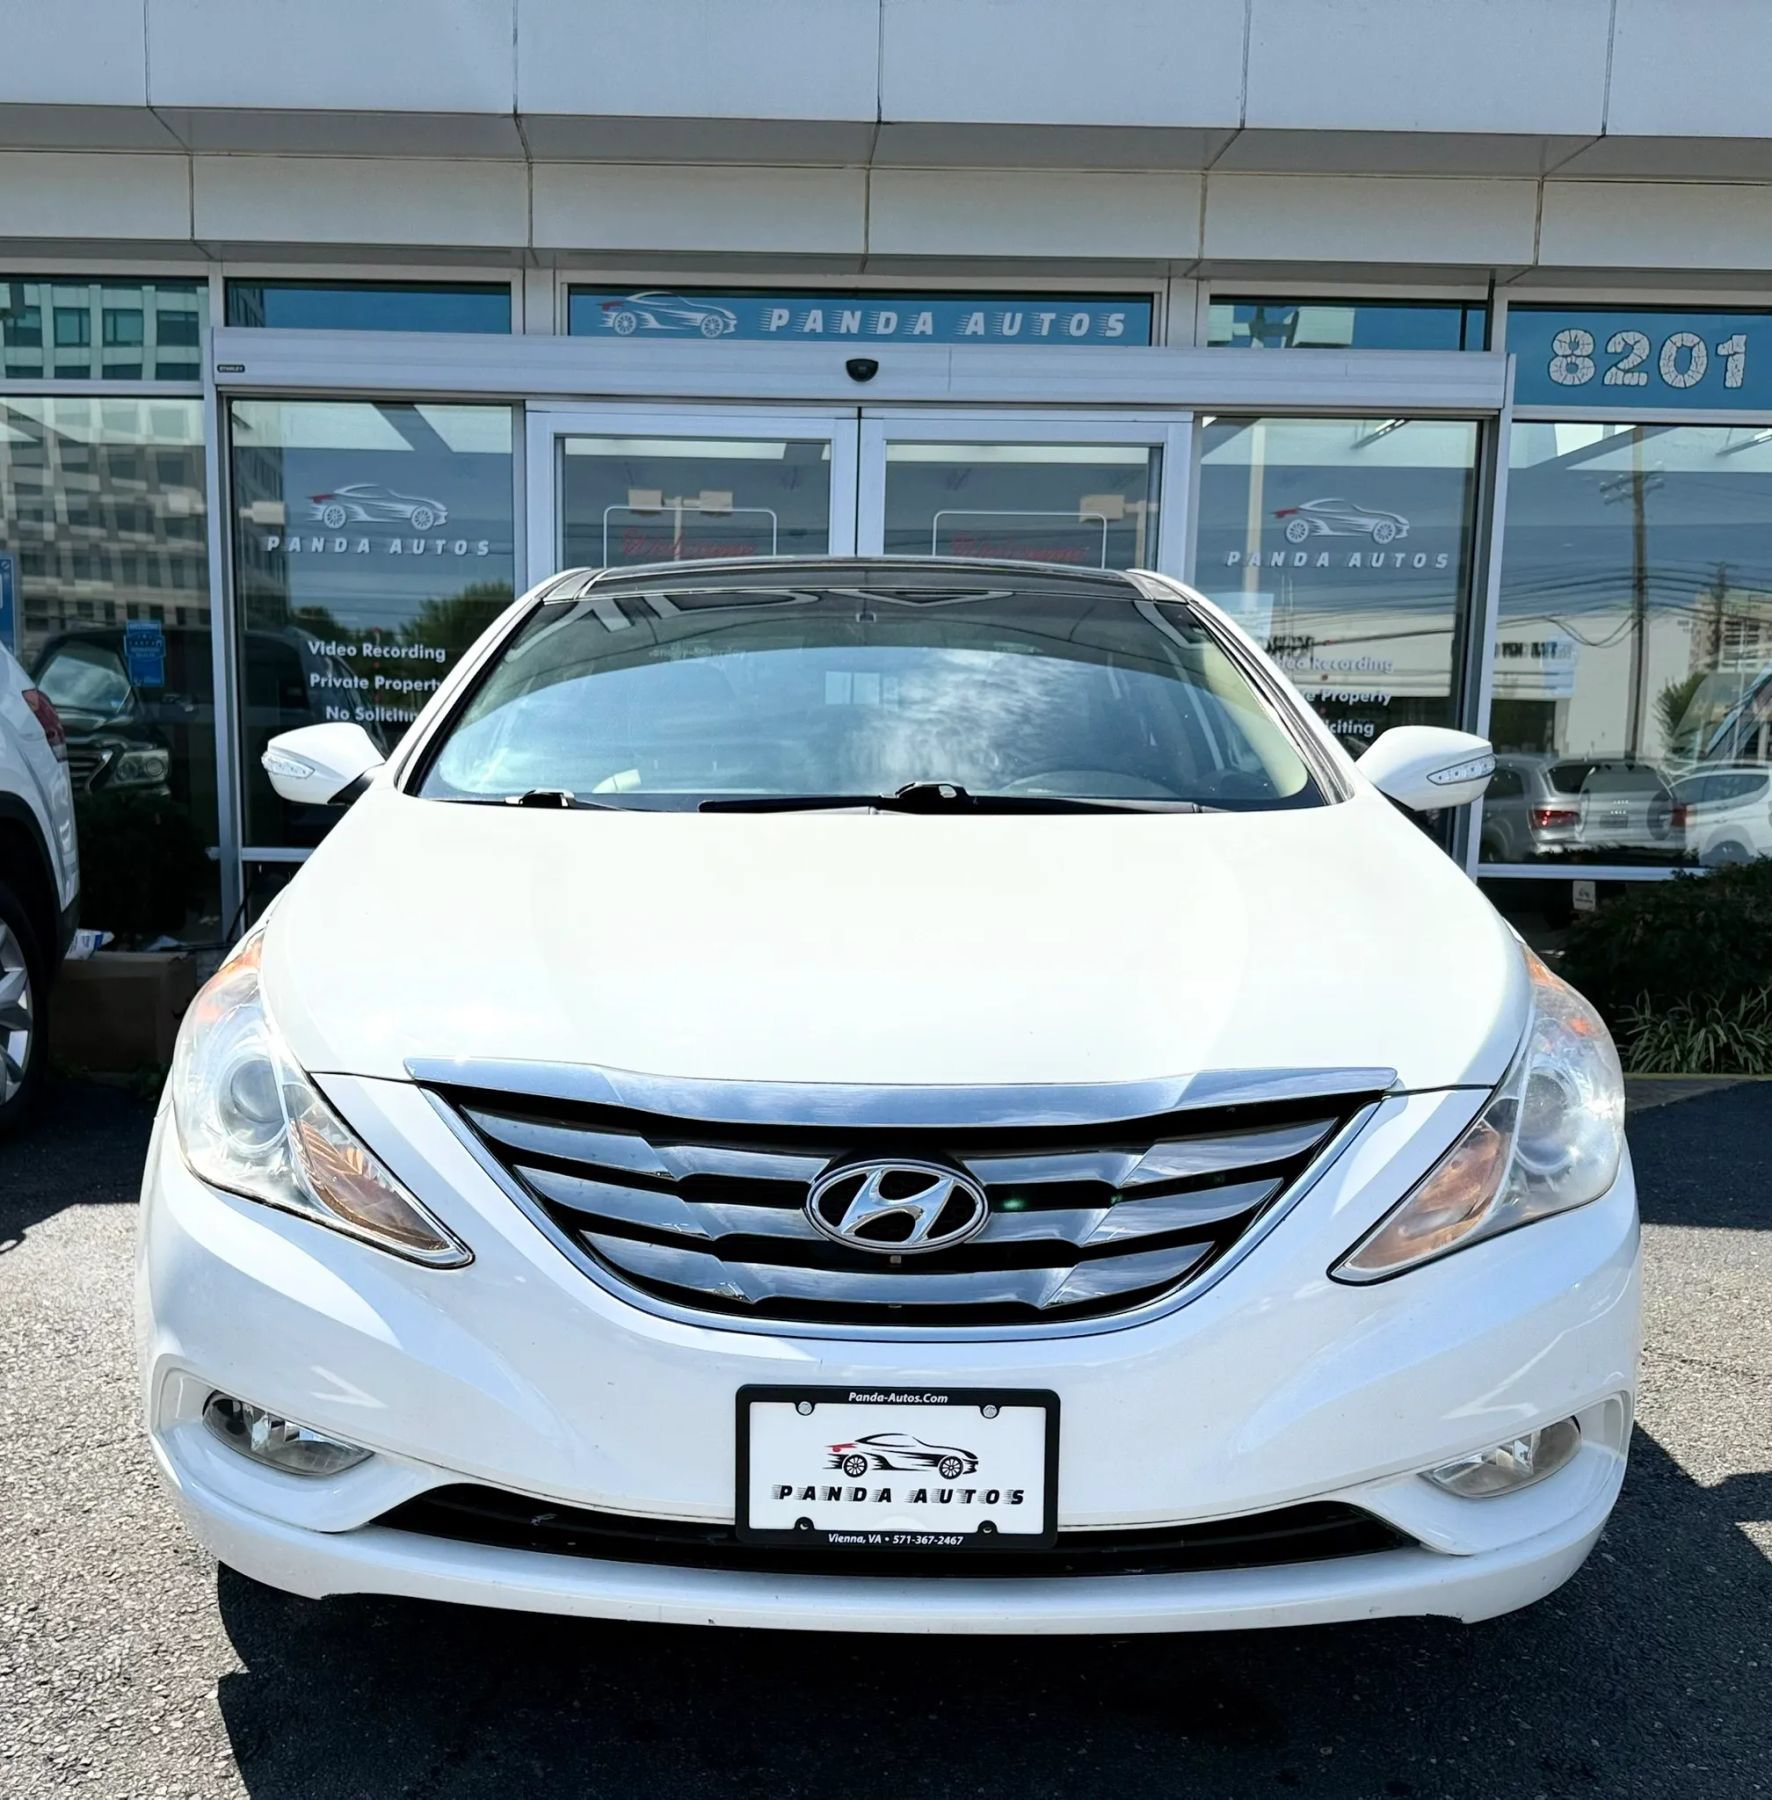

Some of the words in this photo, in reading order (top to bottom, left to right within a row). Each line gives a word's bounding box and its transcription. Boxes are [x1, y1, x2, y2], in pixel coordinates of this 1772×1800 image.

[763, 308, 934, 336] PANDA
[957, 312, 1125, 338] AUTOS
[1548, 328, 1747, 389] 8201
[267, 536, 371, 553] PANDA
[389, 539, 490, 556] AUTOS
[1226, 551, 1330, 568] PANDA
[1348, 552, 1449, 569] AUTOS
[308, 640, 357, 656] Video
[362, 642, 446, 663] Recording
[1312, 656, 1394, 674] Recording
[309, 673, 369, 690] Private
[374, 675, 441, 694] Propert
[1321, 688, 1392, 706] Property
[325, 705, 350, 720] No
[848, 1391, 949, 1404] Panda-Autos.Com
[774, 1485, 892, 1503] PANDA
[907, 1489, 1024, 1505] AUTOS
[828, 1533, 866, 1545] Vienna,
[868, 1534, 882, 1544] VA
[892, 1535, 964, 1546] 571-367-2467
